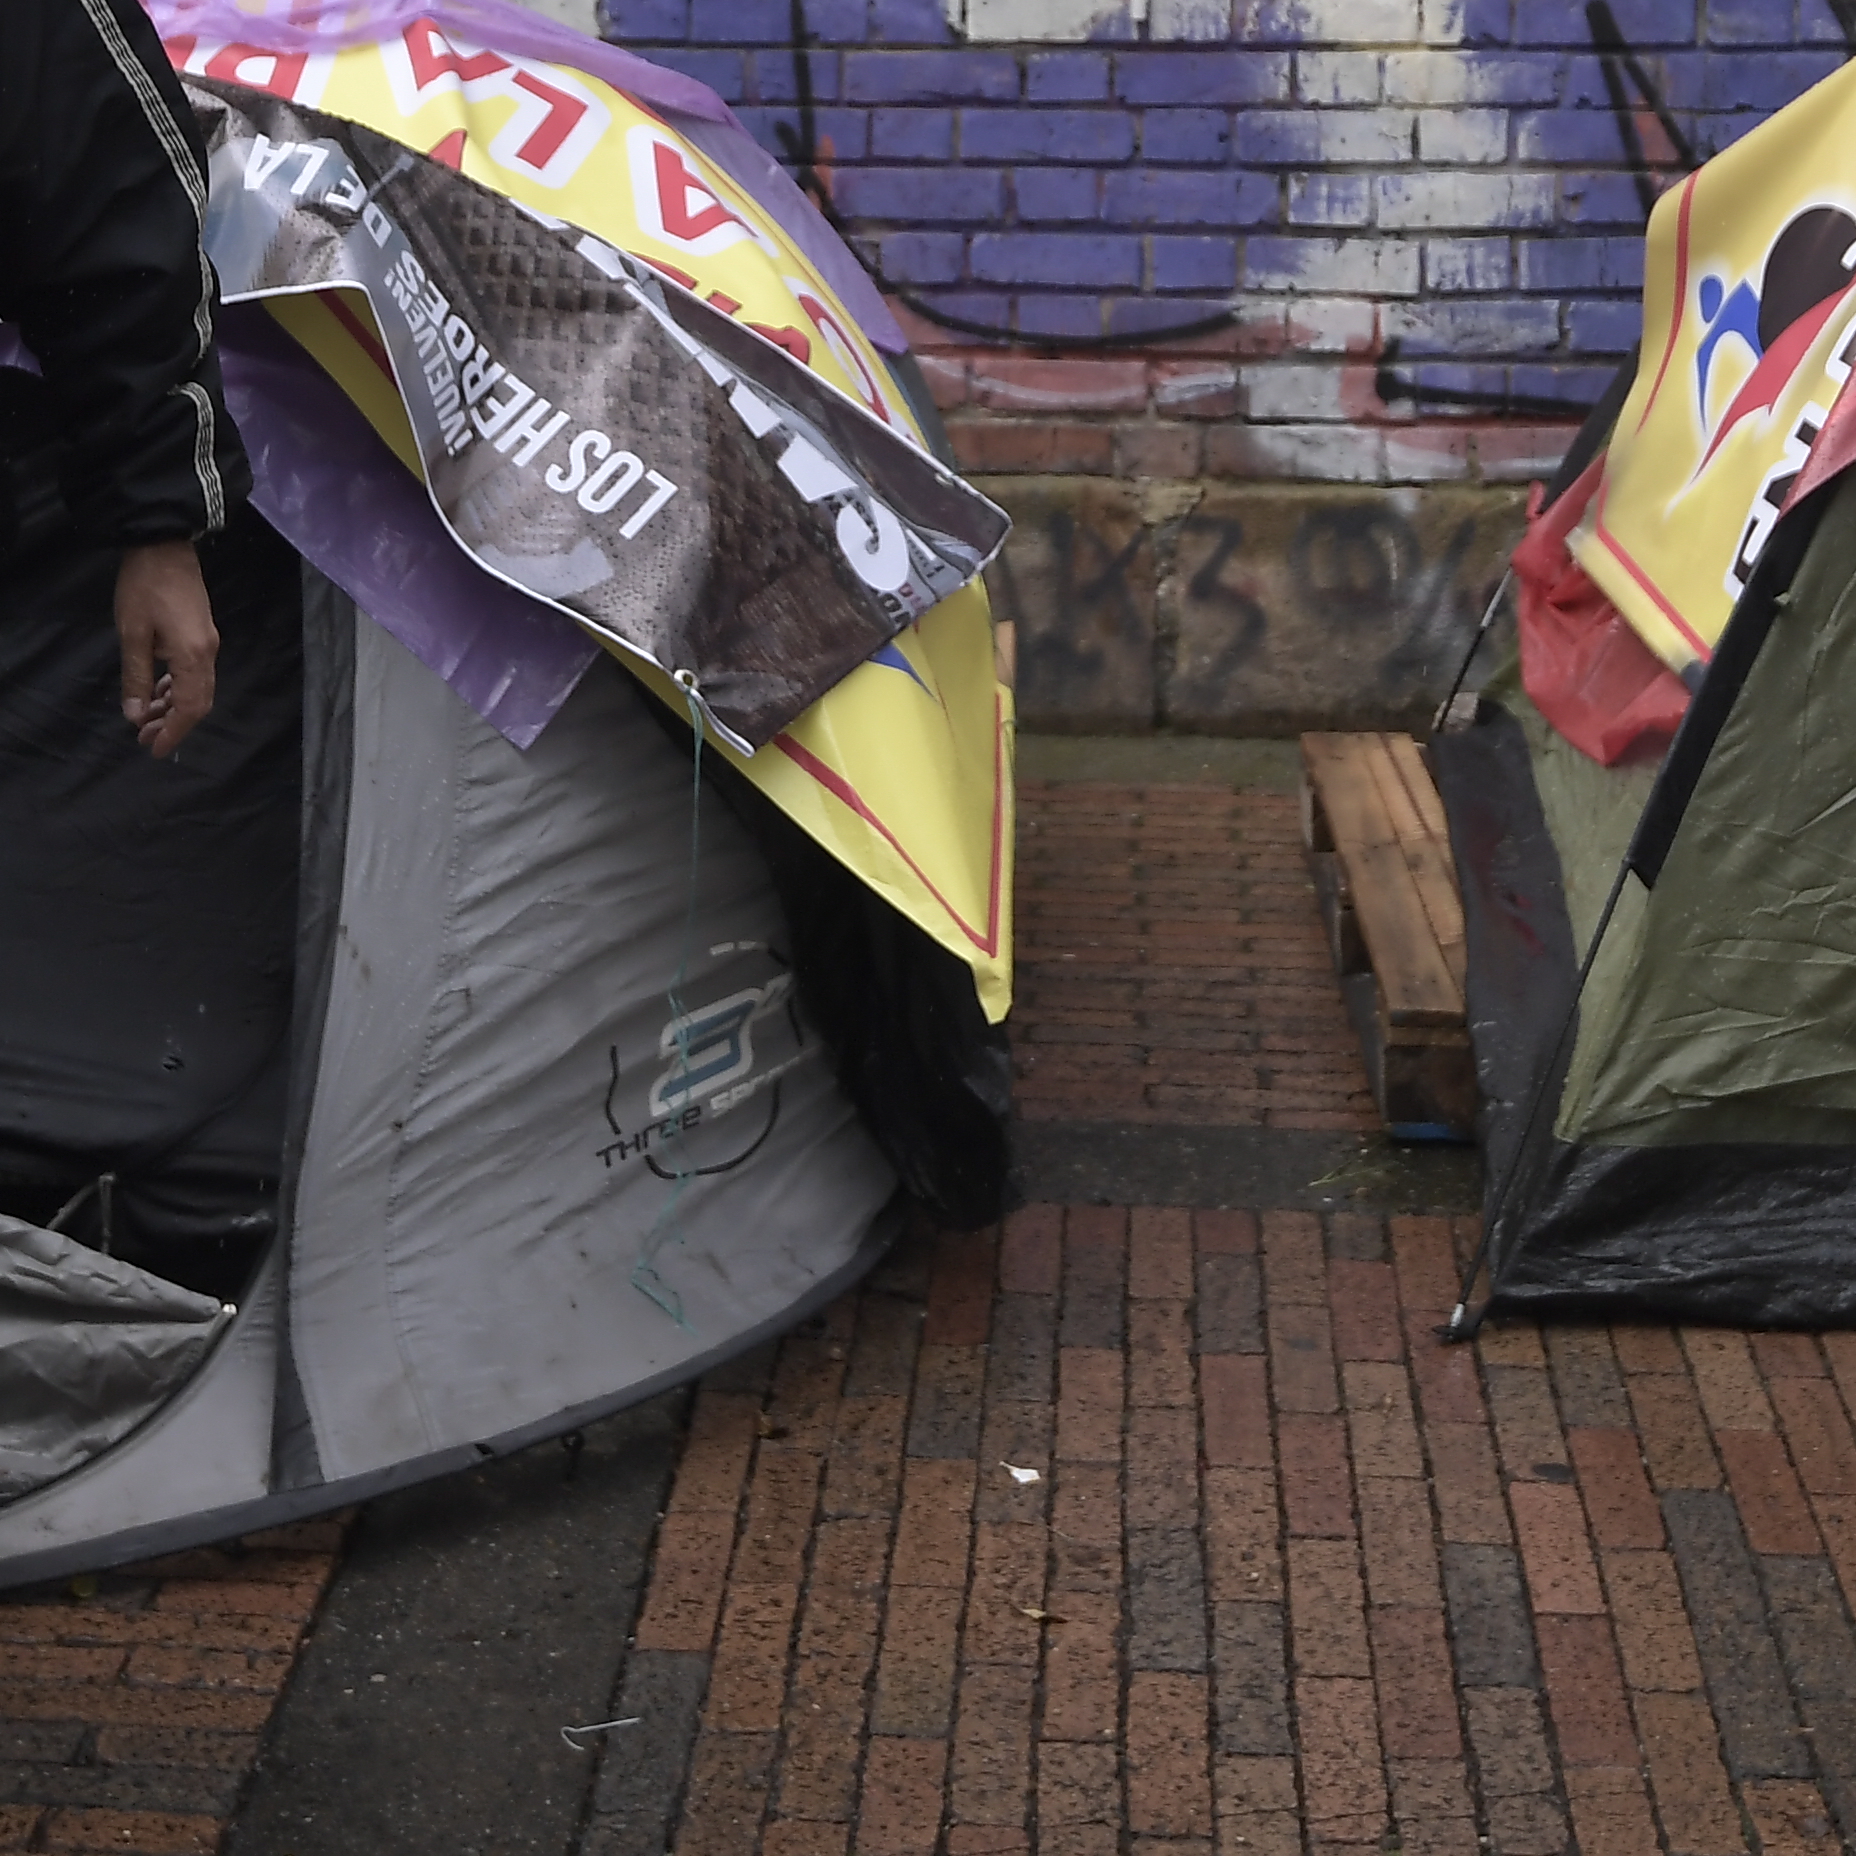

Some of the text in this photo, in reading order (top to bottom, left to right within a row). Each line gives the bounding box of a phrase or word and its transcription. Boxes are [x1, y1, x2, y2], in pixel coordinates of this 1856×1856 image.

[243, 133, 329, 196] LA
[325, 164, 393, 247] DE
[394, 249, 572, 468] HEROES
[544, 428, 679, 540] LOS
